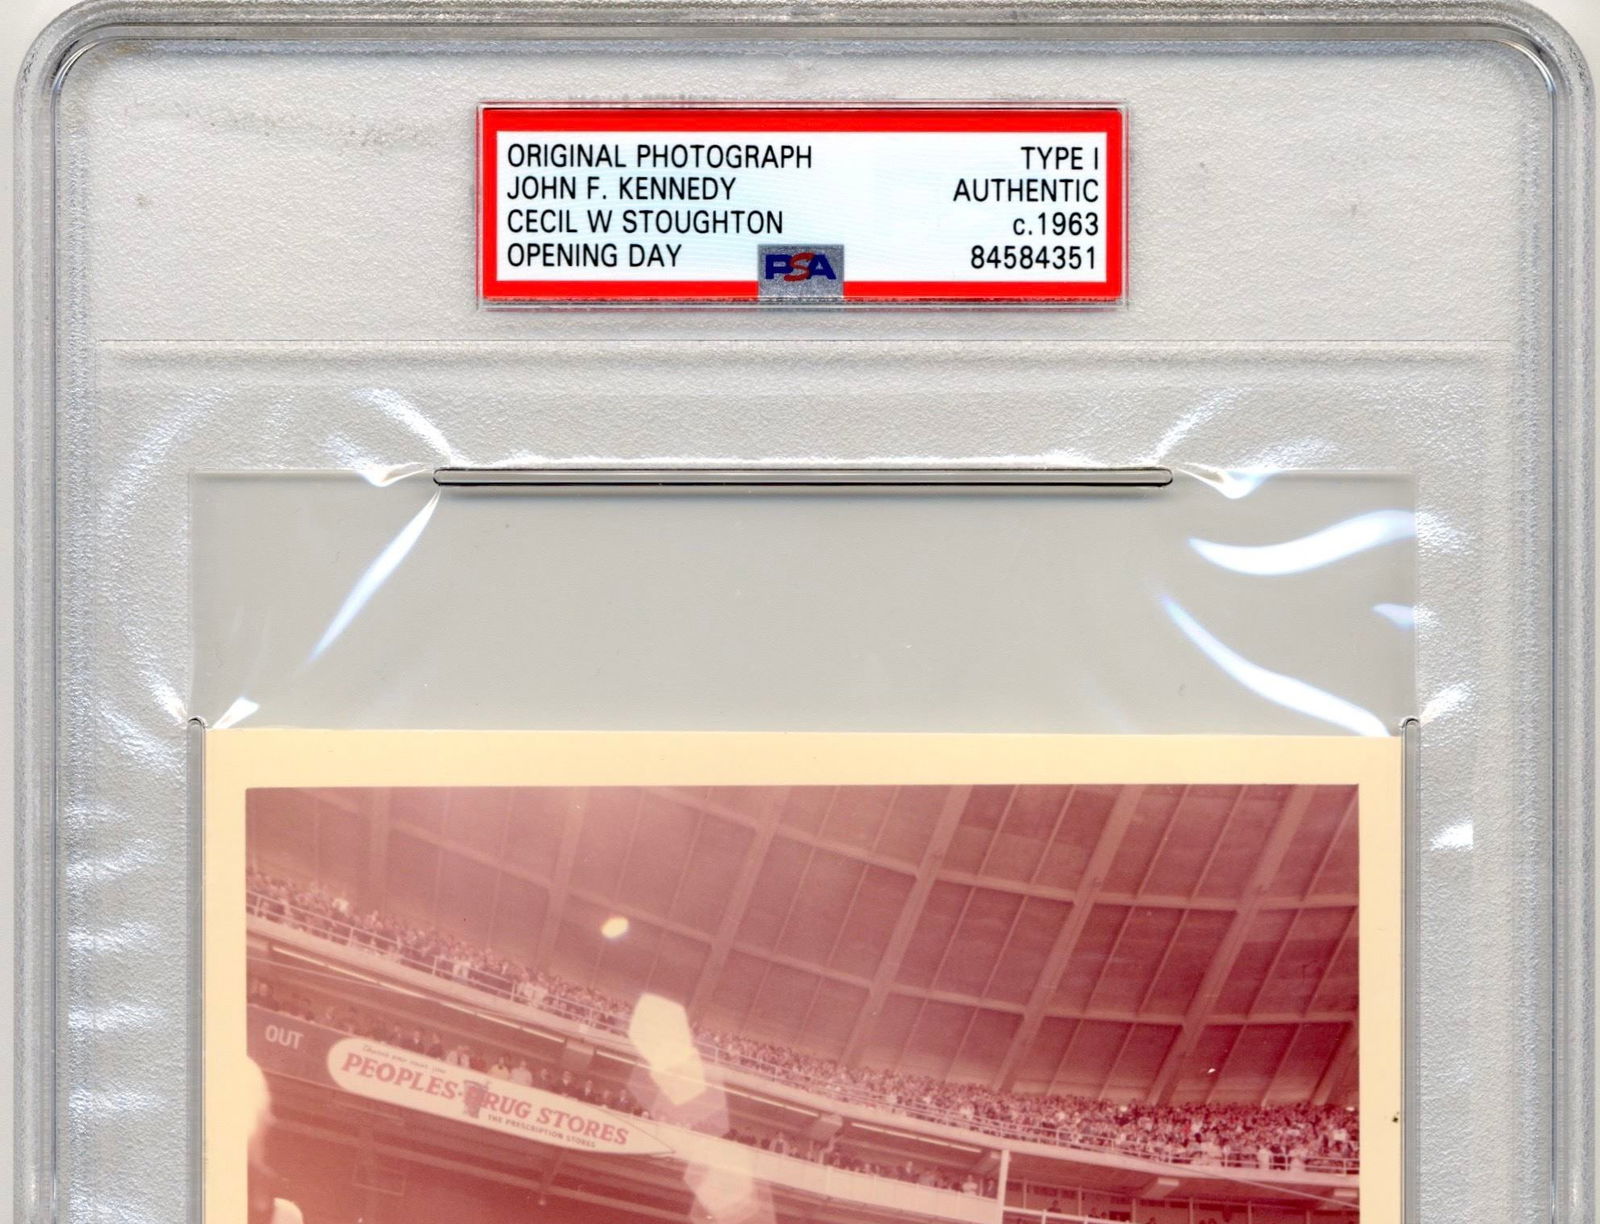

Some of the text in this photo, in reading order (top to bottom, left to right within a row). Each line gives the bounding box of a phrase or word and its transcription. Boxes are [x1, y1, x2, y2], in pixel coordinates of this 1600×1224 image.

[507, 143, 812, 169] ORIGINAL PHOTOGRAPH
[1020, 146, 1099, 171] TYPE I
[506, 175, 736, 201] JOHN F. KENNEDY
[953, 178, 1099, 203] AUTHENTIC
[507, 208, 783, 235] CECIL W STOUGHTON
[1012, 211, 1099, 236] c.1963
[507, 242, 682, 268] OPENING DAY
[765, 252, 837, 282] PSA
[970, 244, 1095, 270] 84584351
[265, 1024, 305, 1050] OUT
[342, 1052, 459, 1100] PEOPLES
[536, 1106, 630, 1146] STORES
[505, 1117, 564, 1140] PRESCRIPTION
[565, 1134, 597, 1149] STORES
